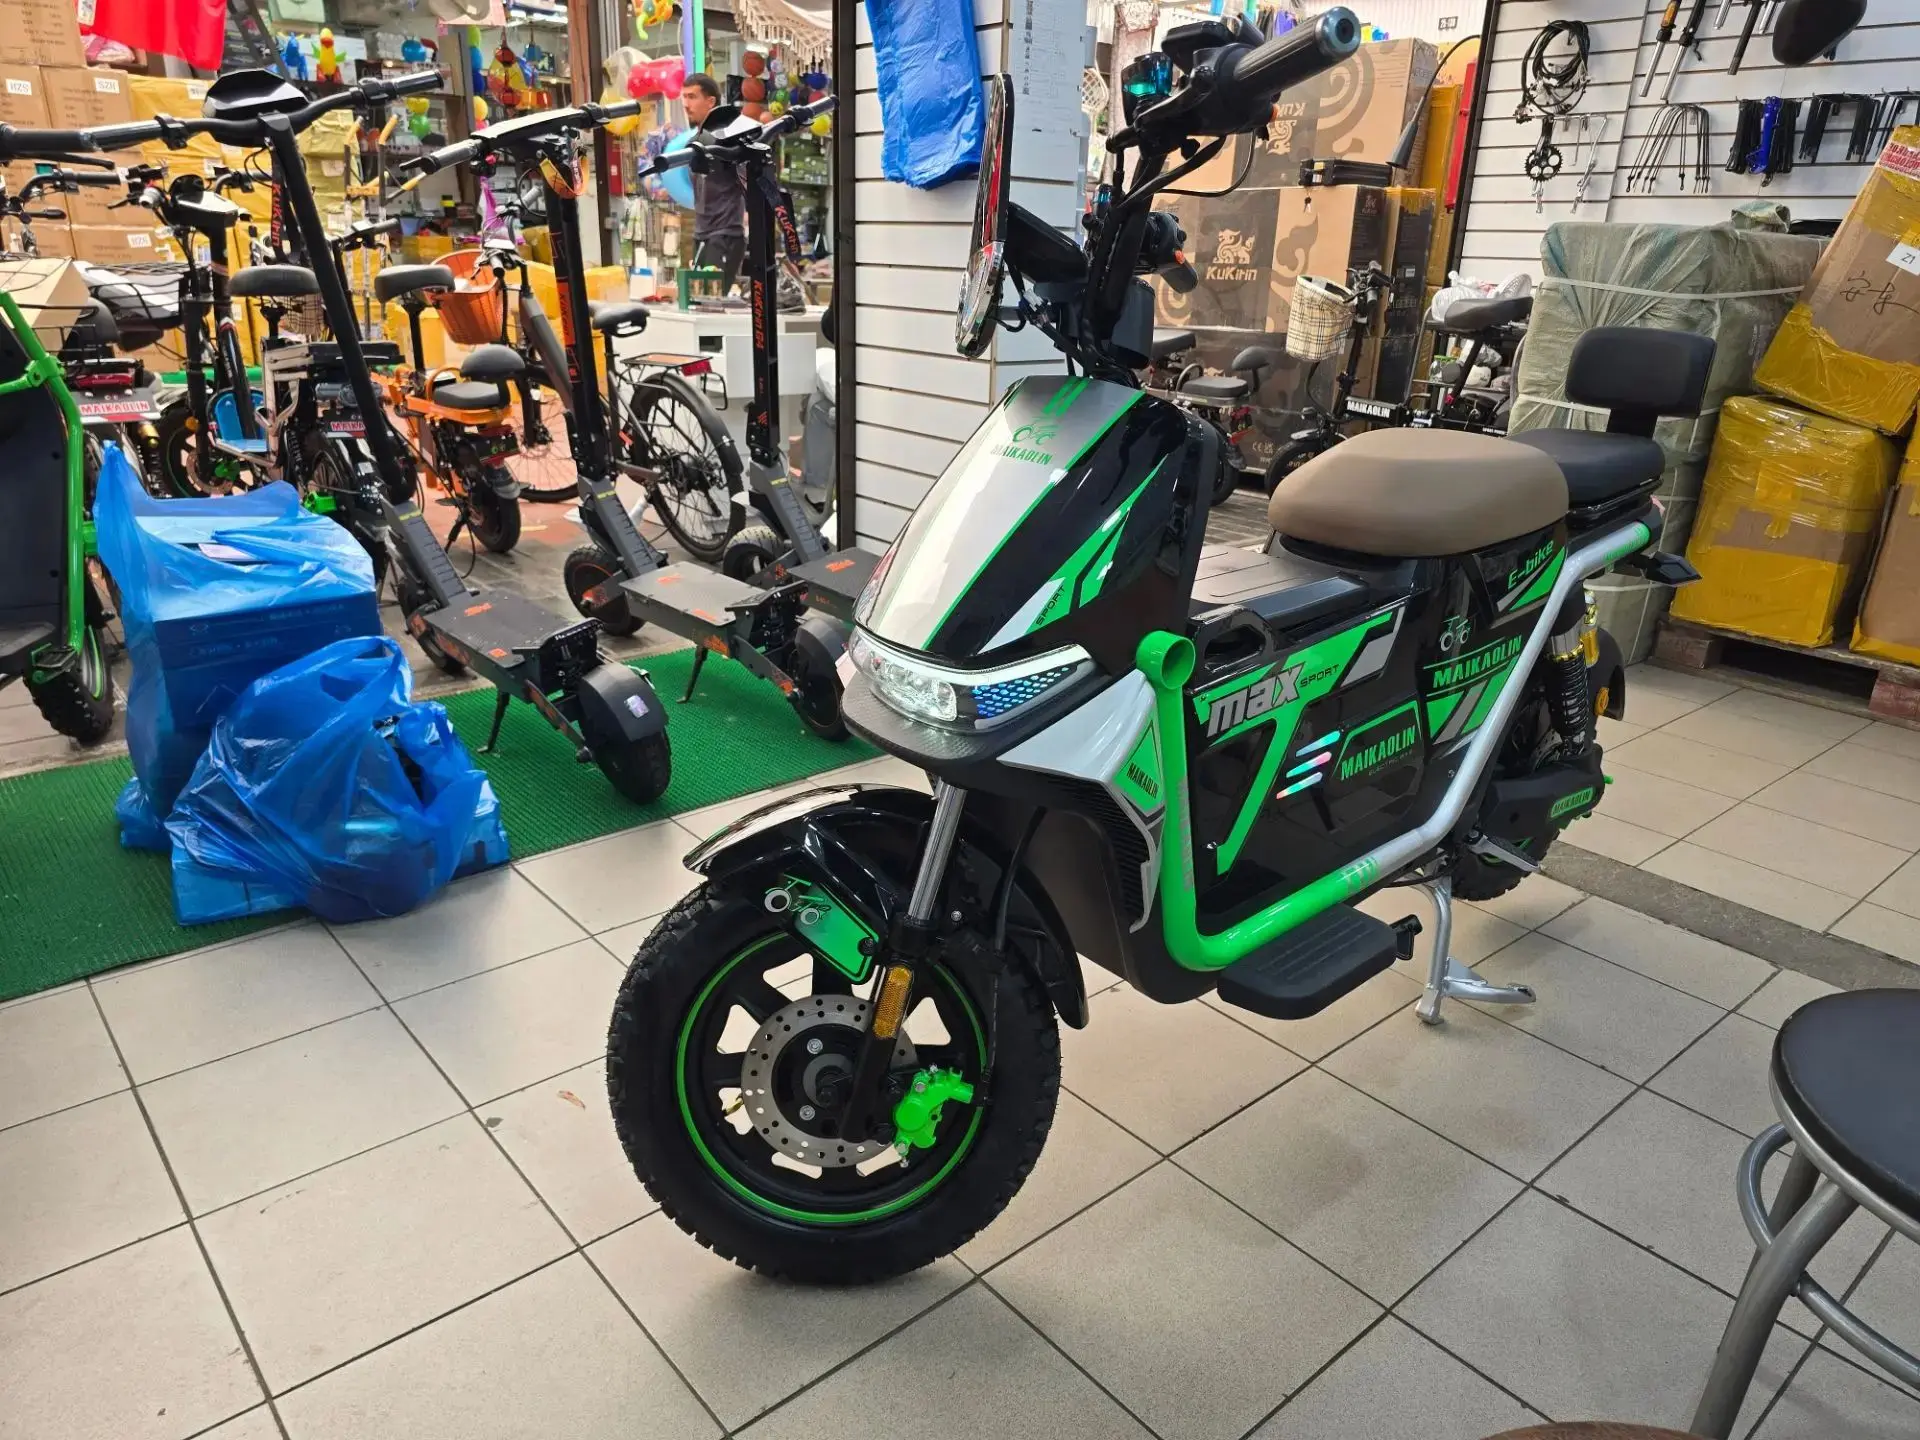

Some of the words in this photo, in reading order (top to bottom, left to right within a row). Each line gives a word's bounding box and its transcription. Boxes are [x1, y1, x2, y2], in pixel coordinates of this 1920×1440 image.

[331, 421, 365, 432] MAIKA
[1346, 401, 1391, 419] MAIKAOLIN
[1508, 540, 1554, 590] E-bike
[1035, 585, 1066, 626] SPORT
[1300, 664, 1340, 688] SPORT
[1433, 635, 1523, 689] MAIKAOLIN
[1340, 725, 1416, 781] MAIKAOLIN
[1127, 762, 1160, 800] MAIKAOLIN
